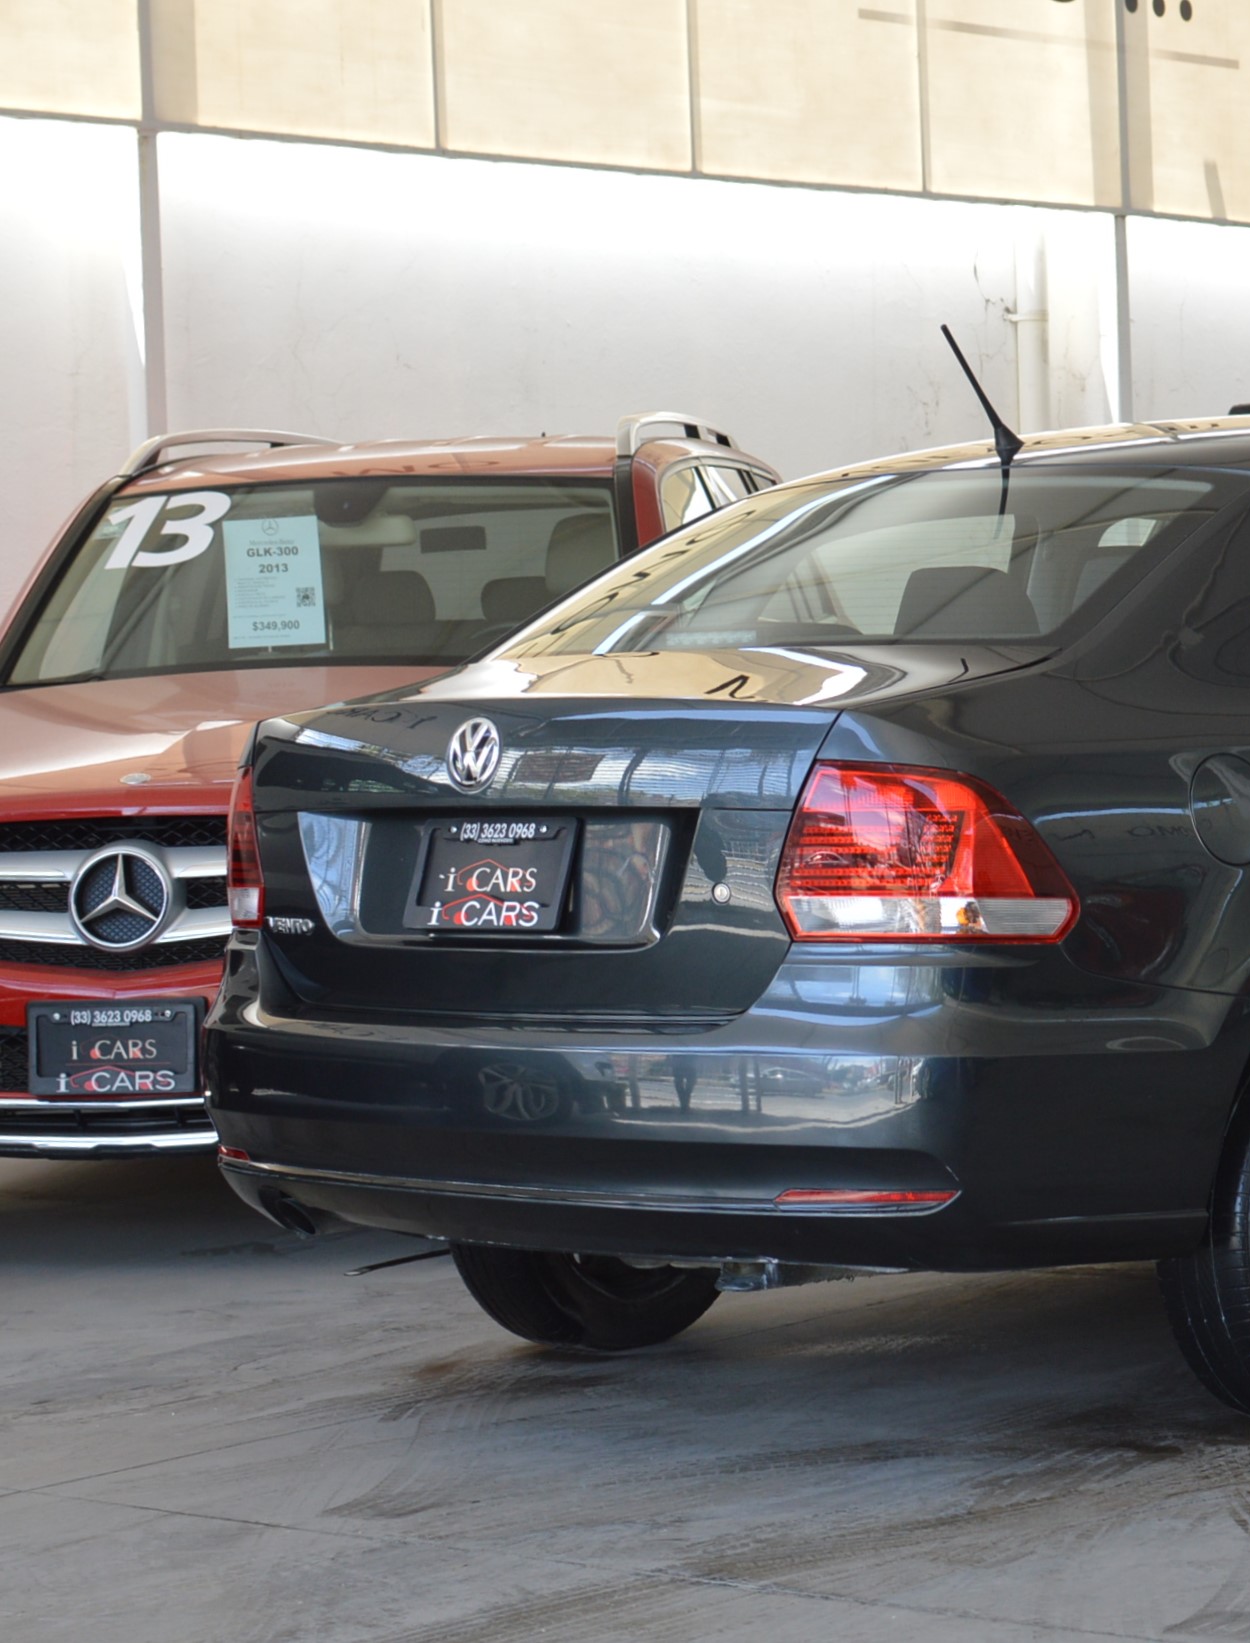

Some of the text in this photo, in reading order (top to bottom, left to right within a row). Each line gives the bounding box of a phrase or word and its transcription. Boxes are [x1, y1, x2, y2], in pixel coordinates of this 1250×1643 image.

[104, 490, 232, 570] 13
[246, 546, 299, 558] GLK-300
[258, 563, 289, 574] 2013
[252, 620, 300, 631] $349,900
[460, 822, 536, 841] (33) 3623 0968
[444, 867, 538, 892] i CARS
[427, 900, 540, 927] i CARS
[71, 1010, 91, 1026] (33)
[93, 1010, 120, 1023] 3623
[123, 1010, 152, 1023] 0968
[71, 1039, 157, 1060] i CARS
[56, 1070, 176, 1092] i CARS
